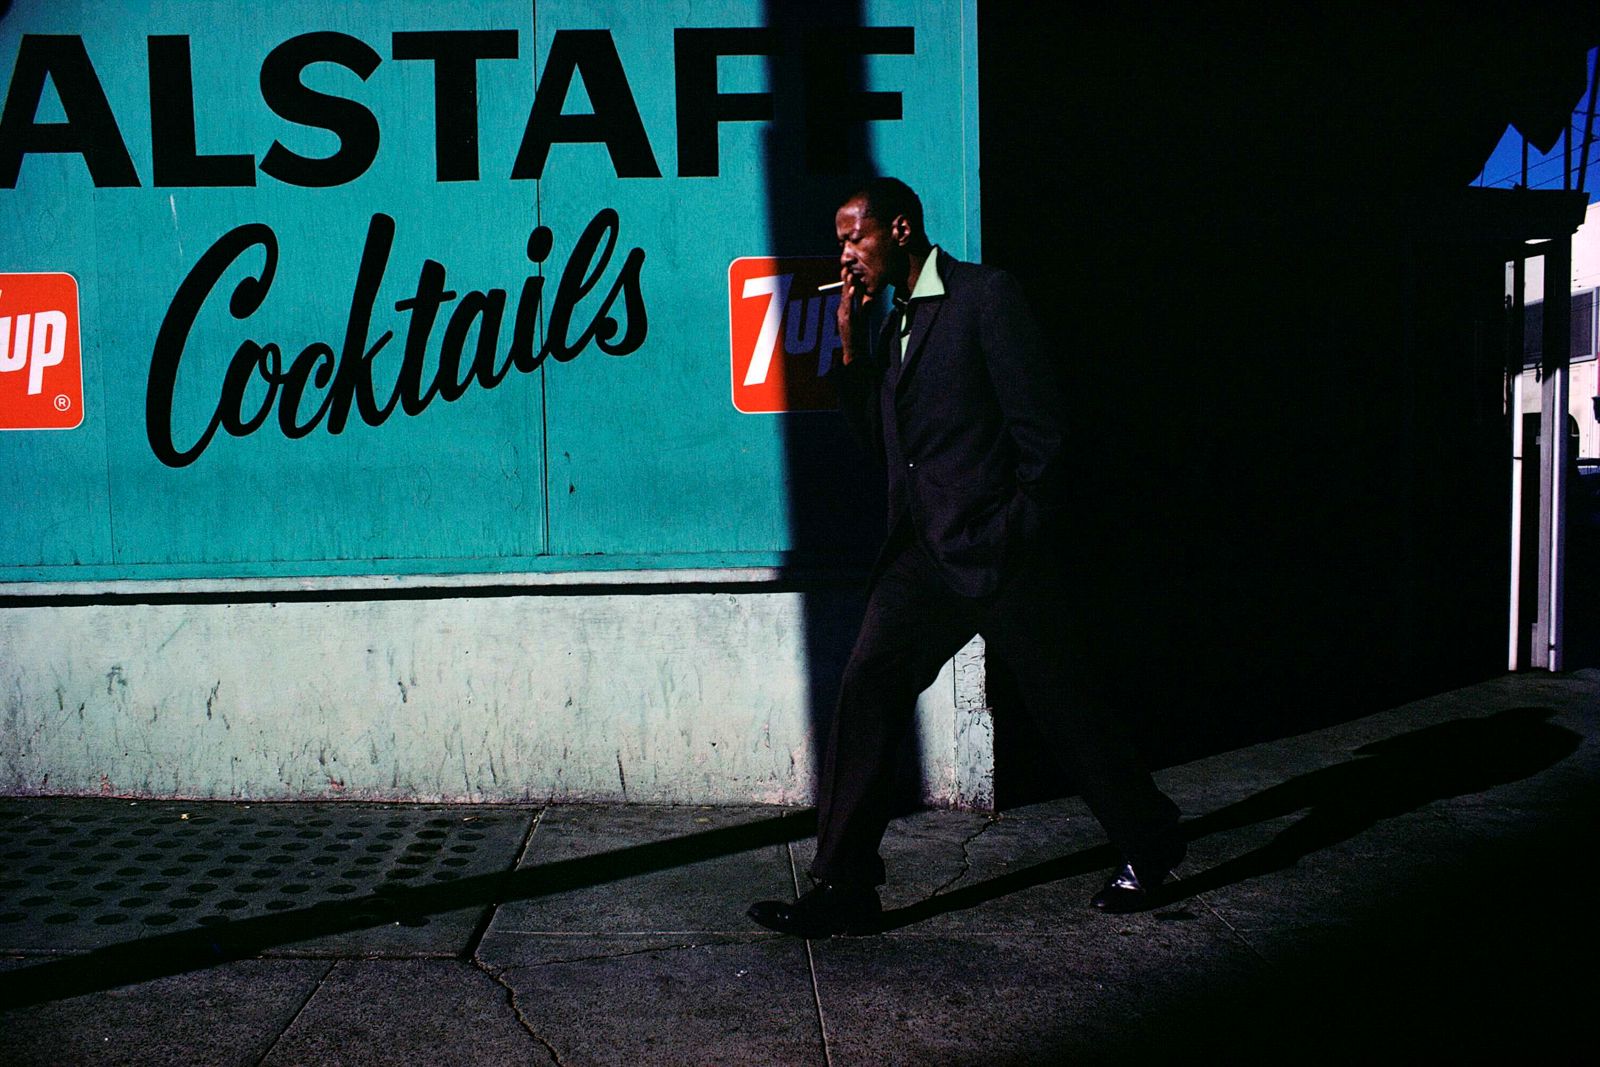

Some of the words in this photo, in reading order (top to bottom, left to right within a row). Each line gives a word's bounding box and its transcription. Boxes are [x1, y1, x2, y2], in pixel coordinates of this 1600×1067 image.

[0, 26, 915, 189] ALSTAFF
[0, 289, 68, 396] up
[146, 208, 647, 468] Cocktails
